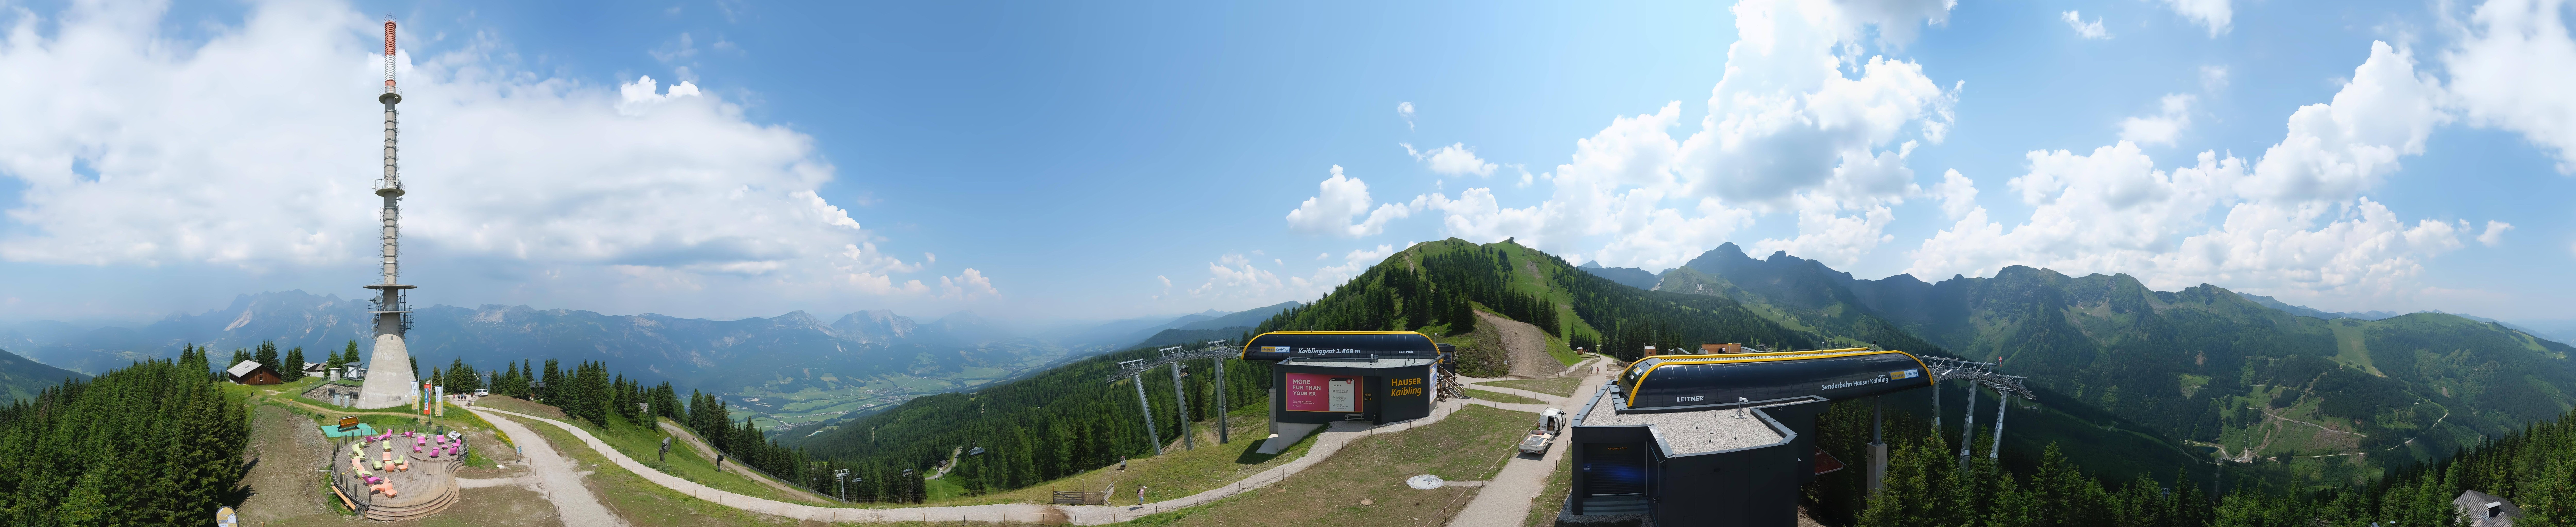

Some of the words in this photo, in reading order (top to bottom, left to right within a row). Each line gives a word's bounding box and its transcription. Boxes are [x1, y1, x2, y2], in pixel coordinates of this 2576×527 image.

[1392, 378, 1421, 386] HAUSER
[1822, 382, 1852, 390] Senderbahn
[1391, 387, 1421, 396] Kaibling
